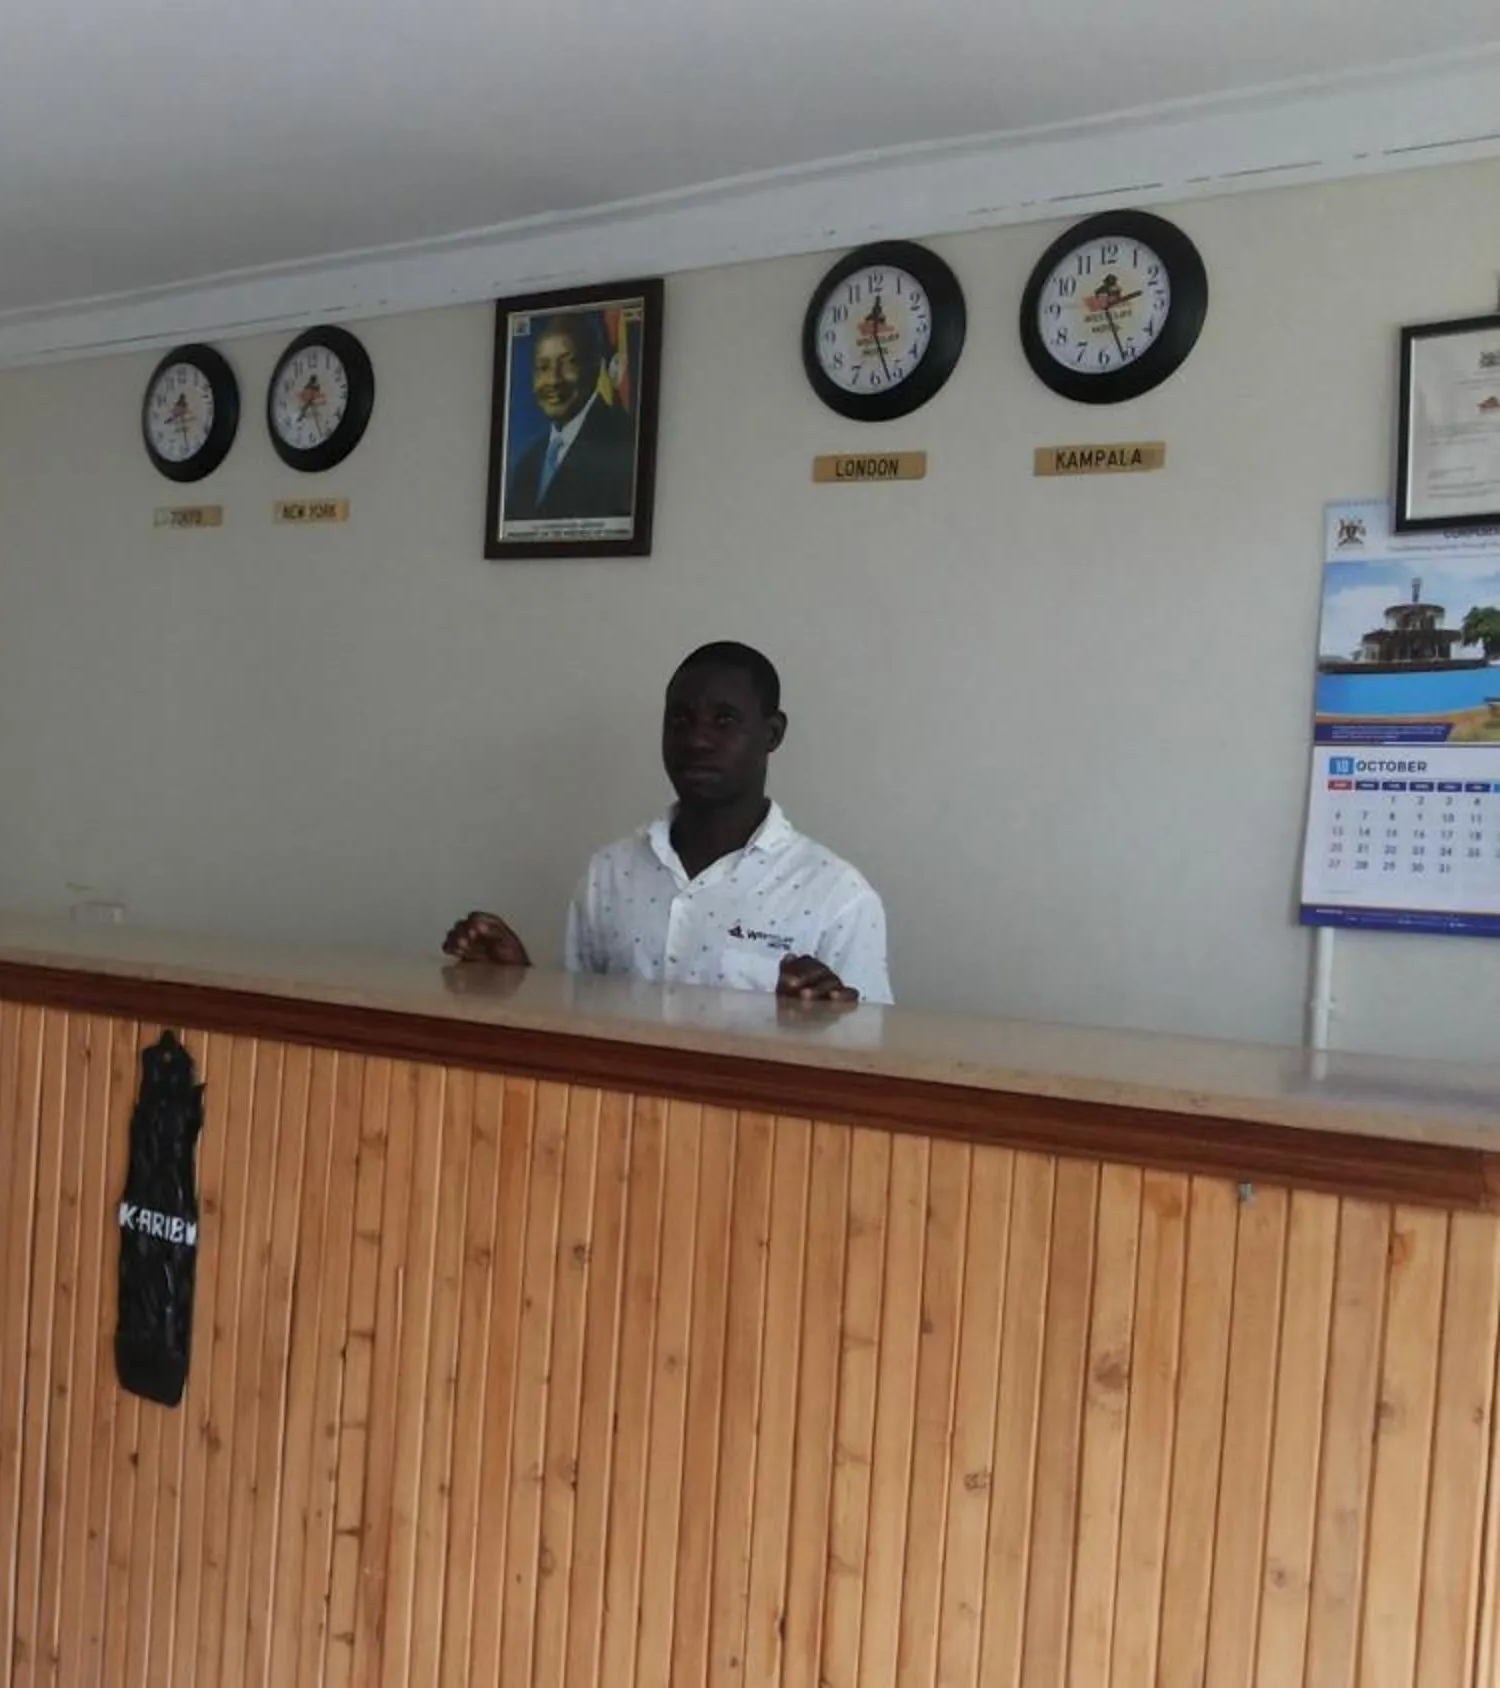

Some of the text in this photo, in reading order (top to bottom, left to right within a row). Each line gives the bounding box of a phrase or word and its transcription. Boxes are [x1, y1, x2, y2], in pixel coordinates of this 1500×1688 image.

[1101, 244, 1118, 265] 12
[1133, 247, 1138, 269] 1
[1078, 255, 1090, 276] 11
[868, 272, 883, 293] 12
[897, 276, 902, 296] 1
[1147, 265, 1159, 287] 2
[848, 284, 860, 304] 11
[1059, 276, 1076, 298] 10
[910, 292, 920, 311] 2
[833, 304, 849, 324] 10
[1077, 341, 1087, 362] 7
[852, 365, 861, 385] 7
[835, 459, 899, 478] LONDON
[1055, 449, 1143, 470] KAMPALA
[1356, 759, 1428, 773] OCTOBER
[1442, 813, 1454, 823] 10
[1471, 813, 1482, 824] 11
